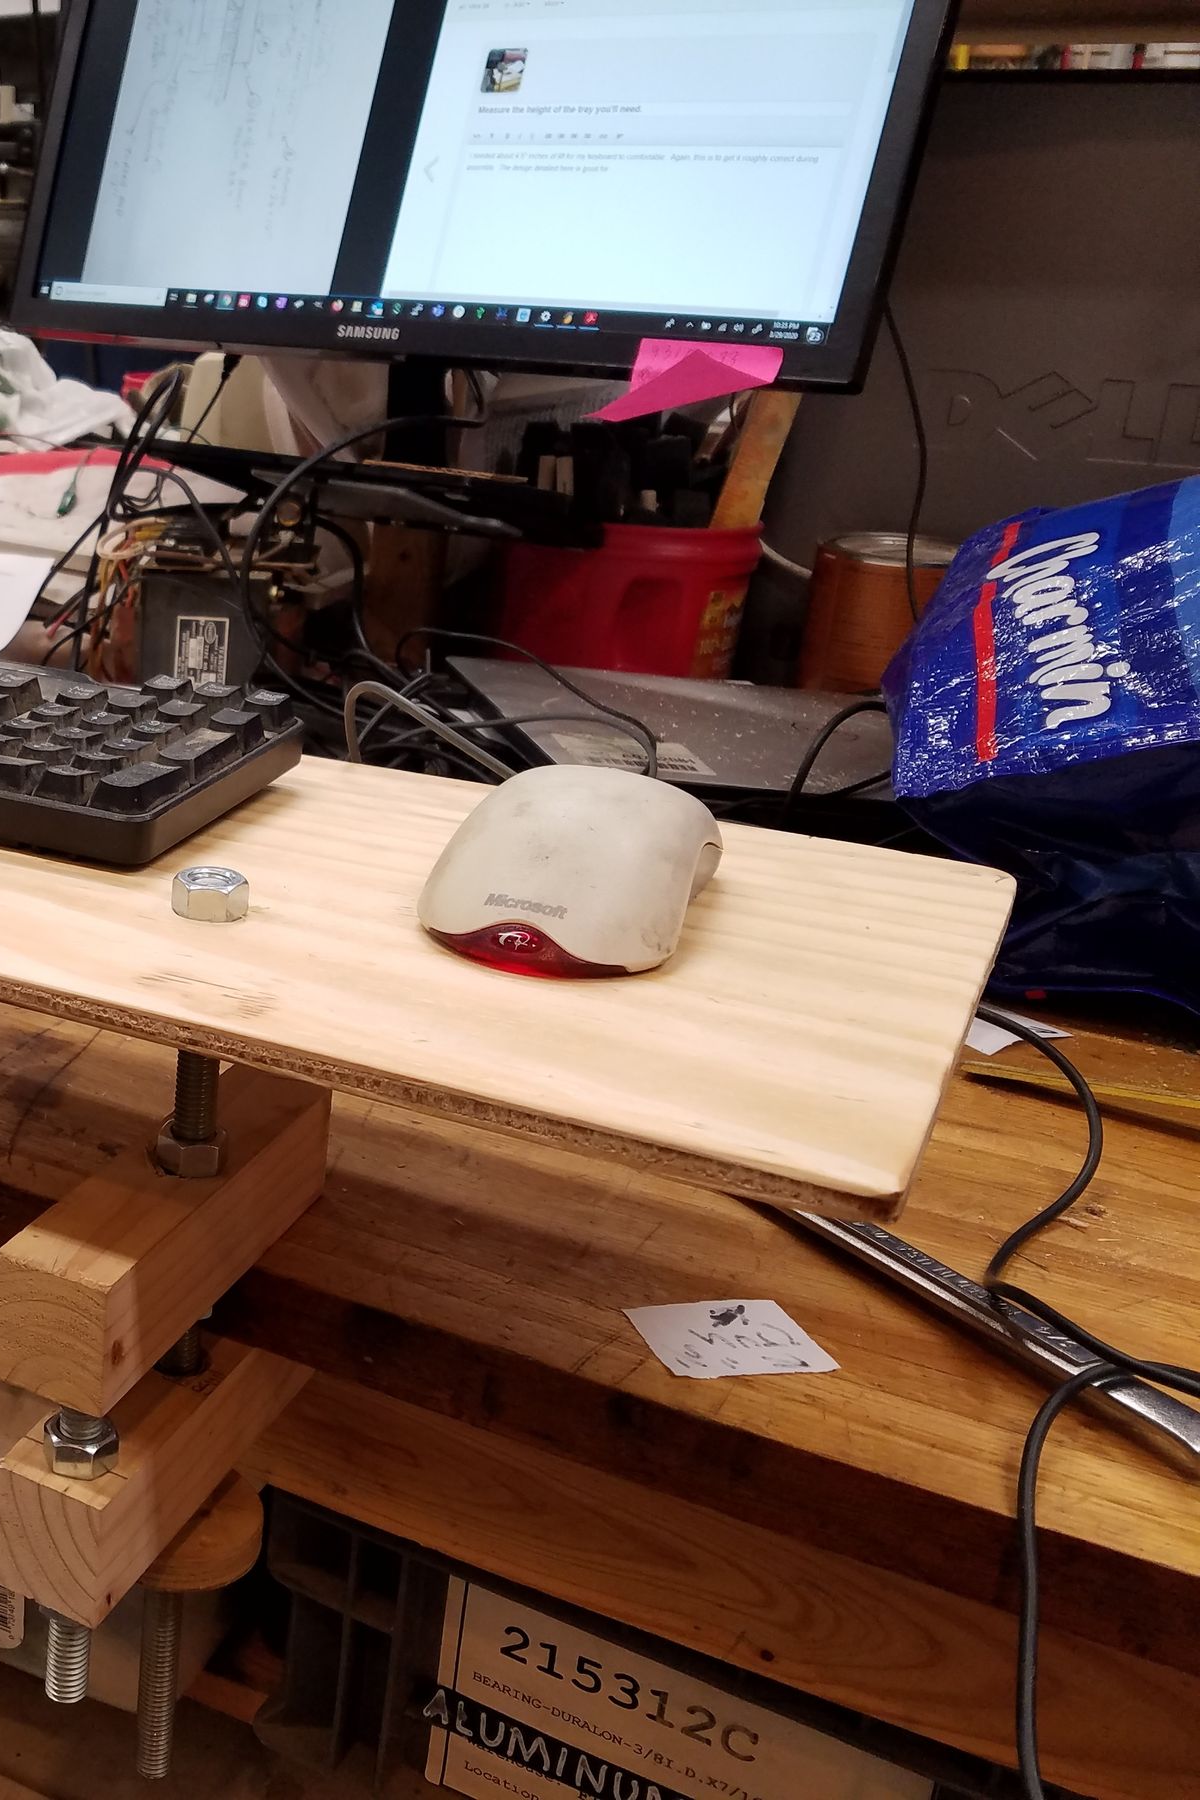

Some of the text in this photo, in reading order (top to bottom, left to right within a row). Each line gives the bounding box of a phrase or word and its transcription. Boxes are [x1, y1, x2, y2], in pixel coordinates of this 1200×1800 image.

[336, 323, 400, 342] SAMSUNG
[986, 531, 1131, 729] Charmin
[484, 893, 569, 920] Microsoft
[499, 1624, 761, 1763] 215312C
